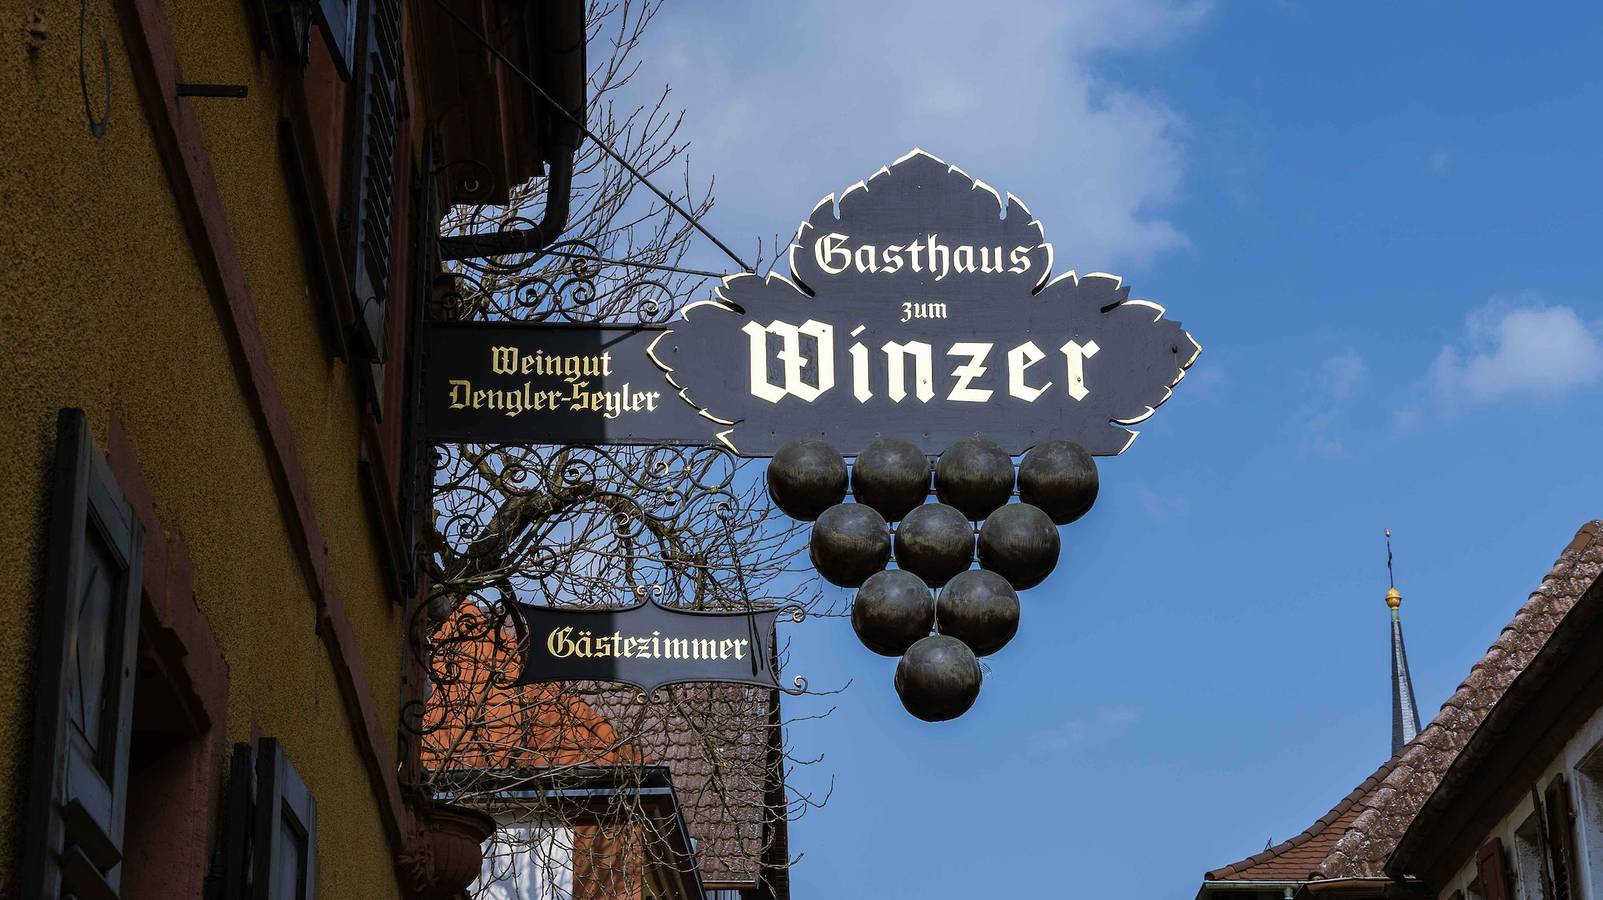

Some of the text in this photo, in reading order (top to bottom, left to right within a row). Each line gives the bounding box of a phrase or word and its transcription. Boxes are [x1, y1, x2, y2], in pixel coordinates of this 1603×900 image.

[814, 233, 1034, 281] Gasthaus
[900, 301, 948, 323] zum
[491, 346, 613, 382] Weingut
[741, 319, 1101, 404] Winzer
[448, 379, 661, 419] Dengler-Seyler
[546, 625, 749, 660] Gästezimmer
